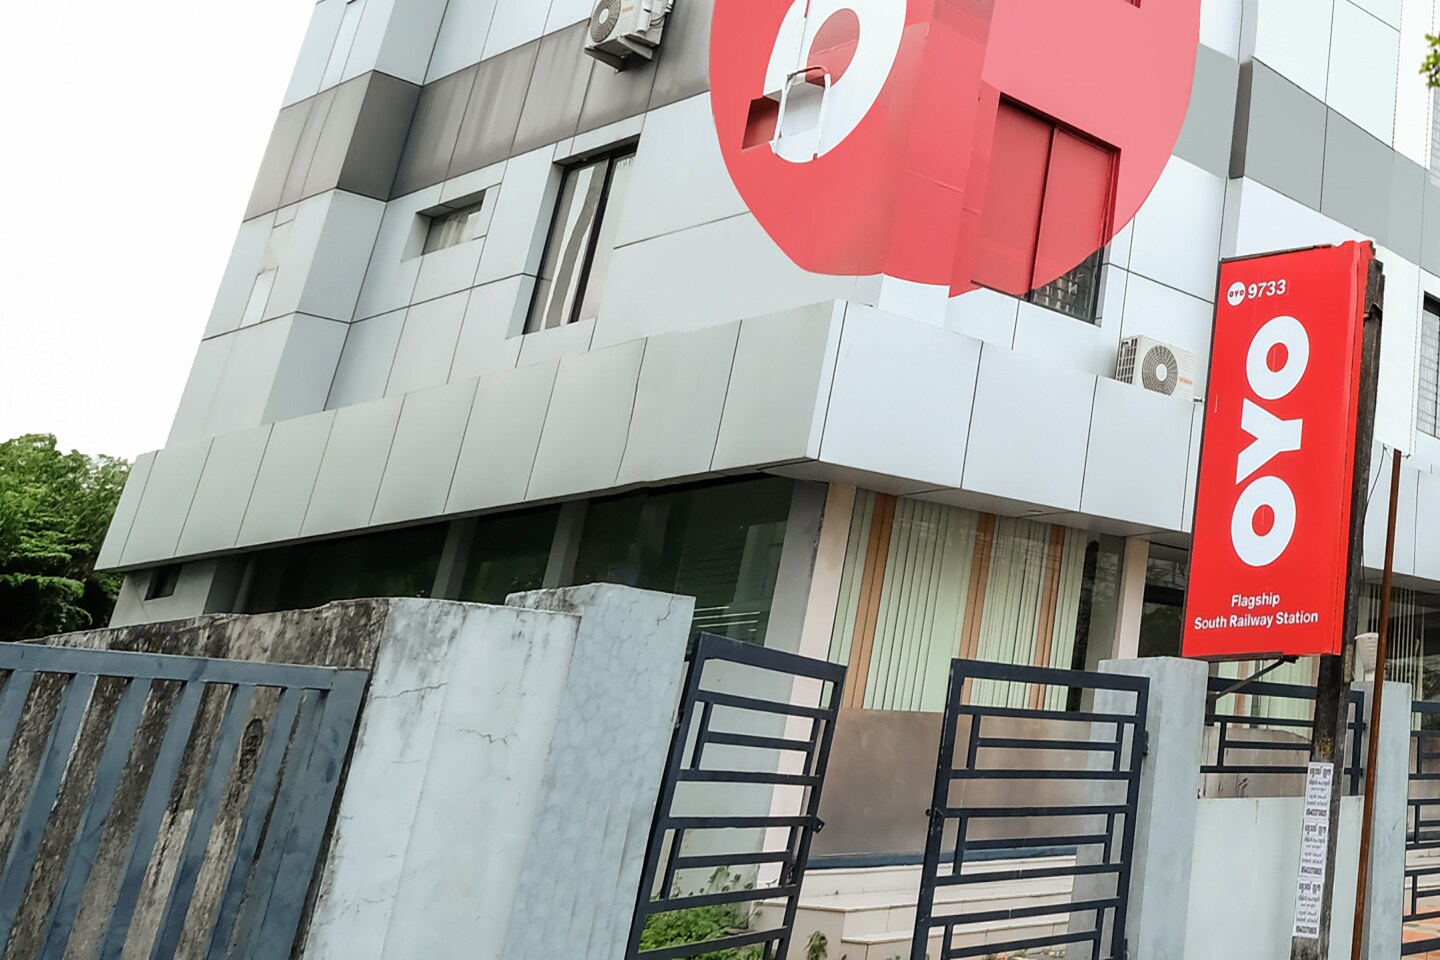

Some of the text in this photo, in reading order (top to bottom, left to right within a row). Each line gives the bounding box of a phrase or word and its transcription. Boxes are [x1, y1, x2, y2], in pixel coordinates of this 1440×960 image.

[1248, 279, 1286, 299] 9733
[1230, 315, 1310, 567] OYO
[1231, 592, 1280, 609] Flagship
[1194, 610, 1318, 630] South Railway Station
